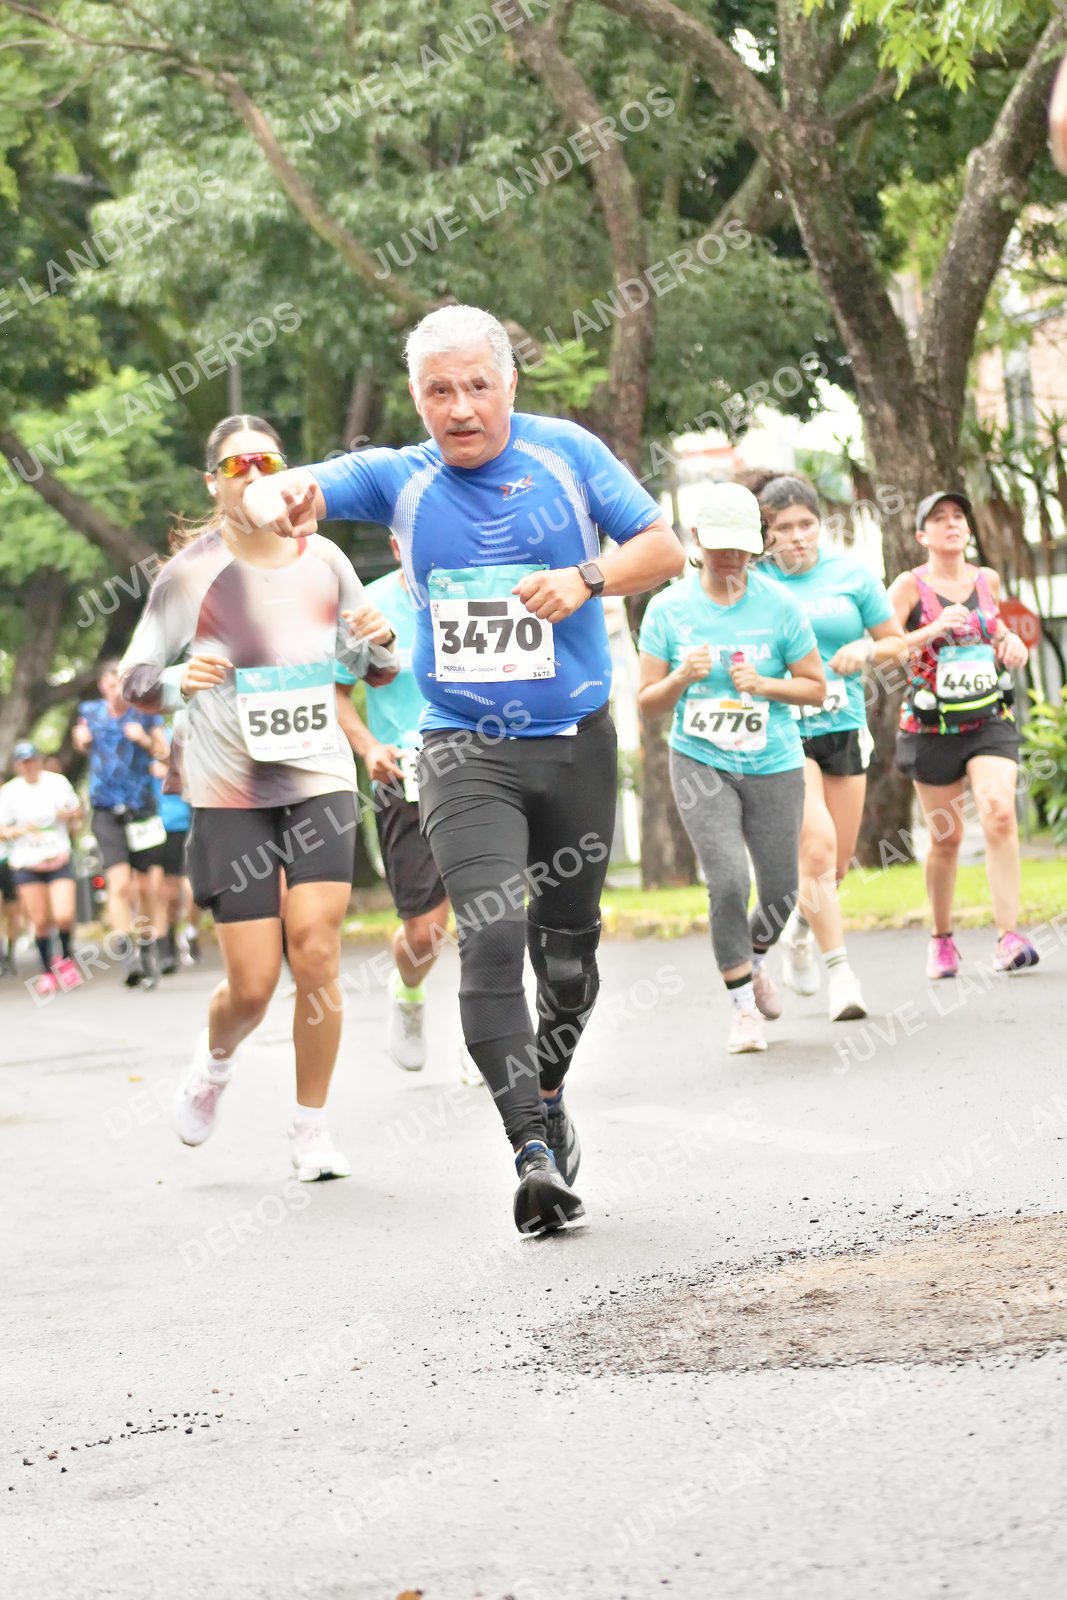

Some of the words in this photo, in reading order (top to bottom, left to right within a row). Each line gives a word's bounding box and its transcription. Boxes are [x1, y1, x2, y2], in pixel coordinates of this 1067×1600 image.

[439, 617, 542, 654] 3470
[248, 703, 328, 737] 5865
[690, 712, 763, 733] 4776
